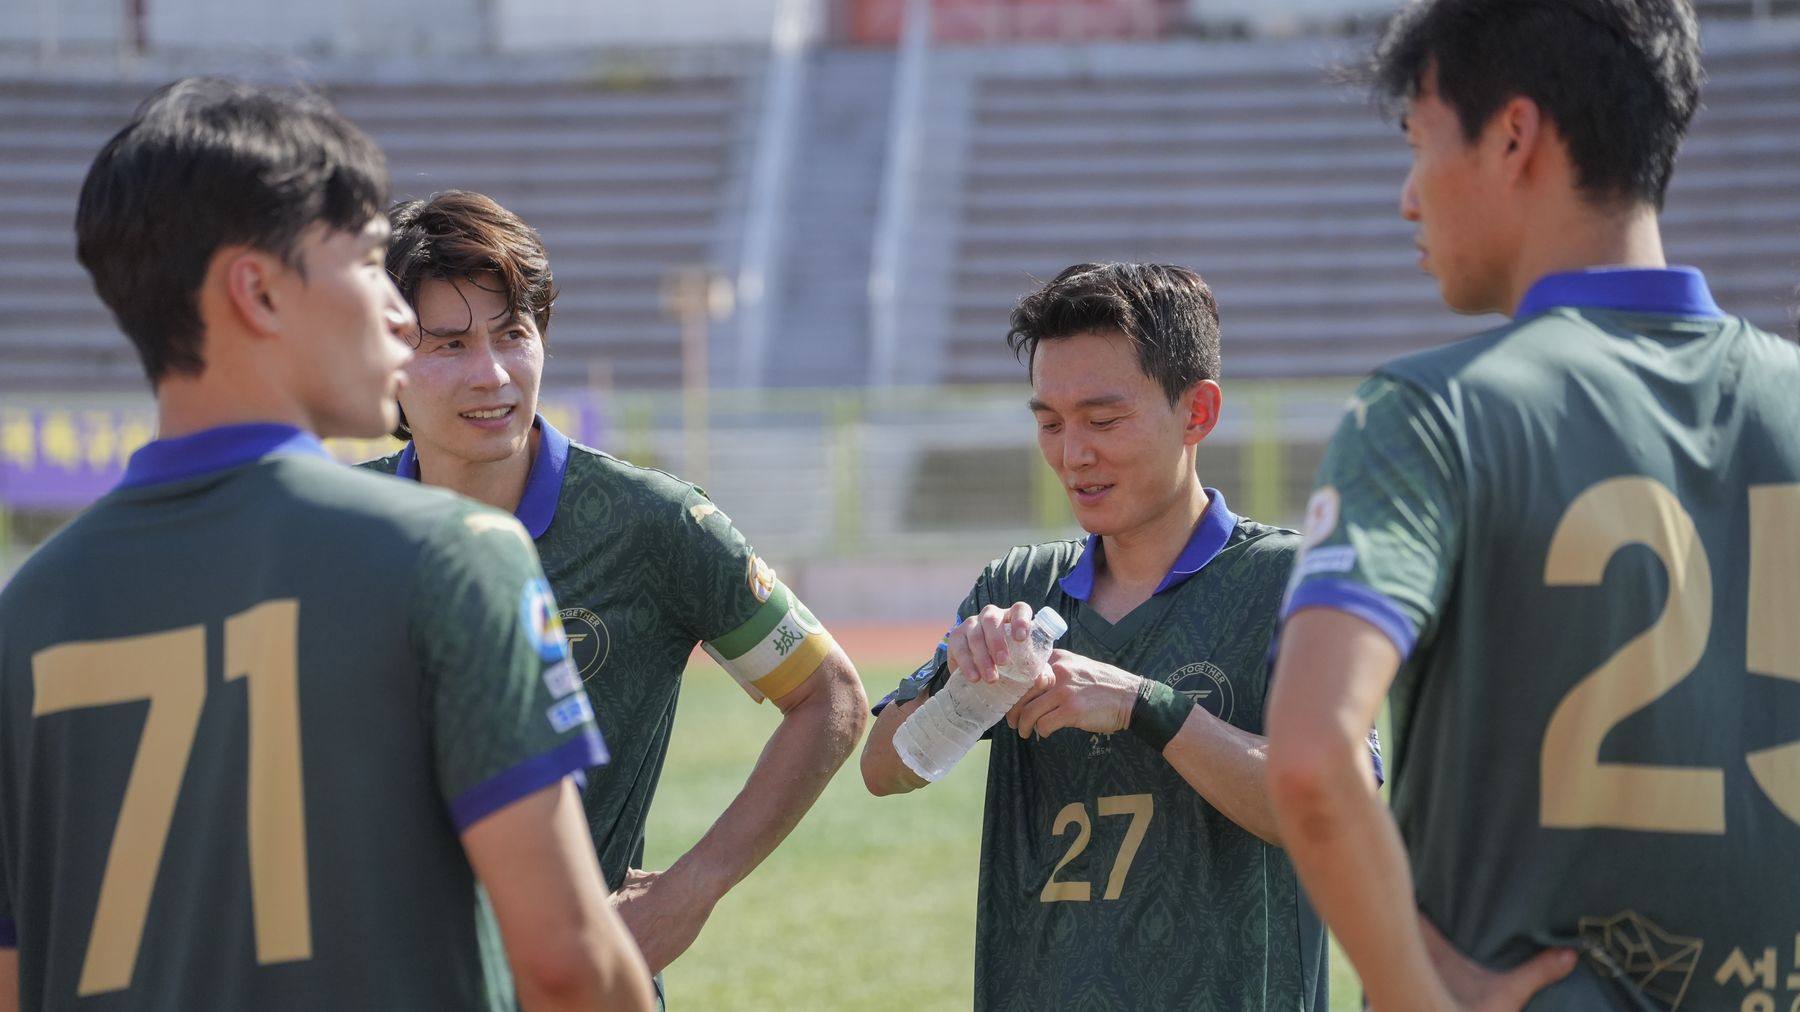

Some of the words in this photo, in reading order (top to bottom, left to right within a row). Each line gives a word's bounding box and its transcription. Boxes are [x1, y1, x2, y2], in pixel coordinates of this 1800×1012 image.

[773, 626, 804, 656] 城
[1167, 673, 1180, 686] FC
[1180, 663, 1226, 685] TOGETHER
[31, 598, 312, 997] 71
[1040, 793, 1153, 902] 27
